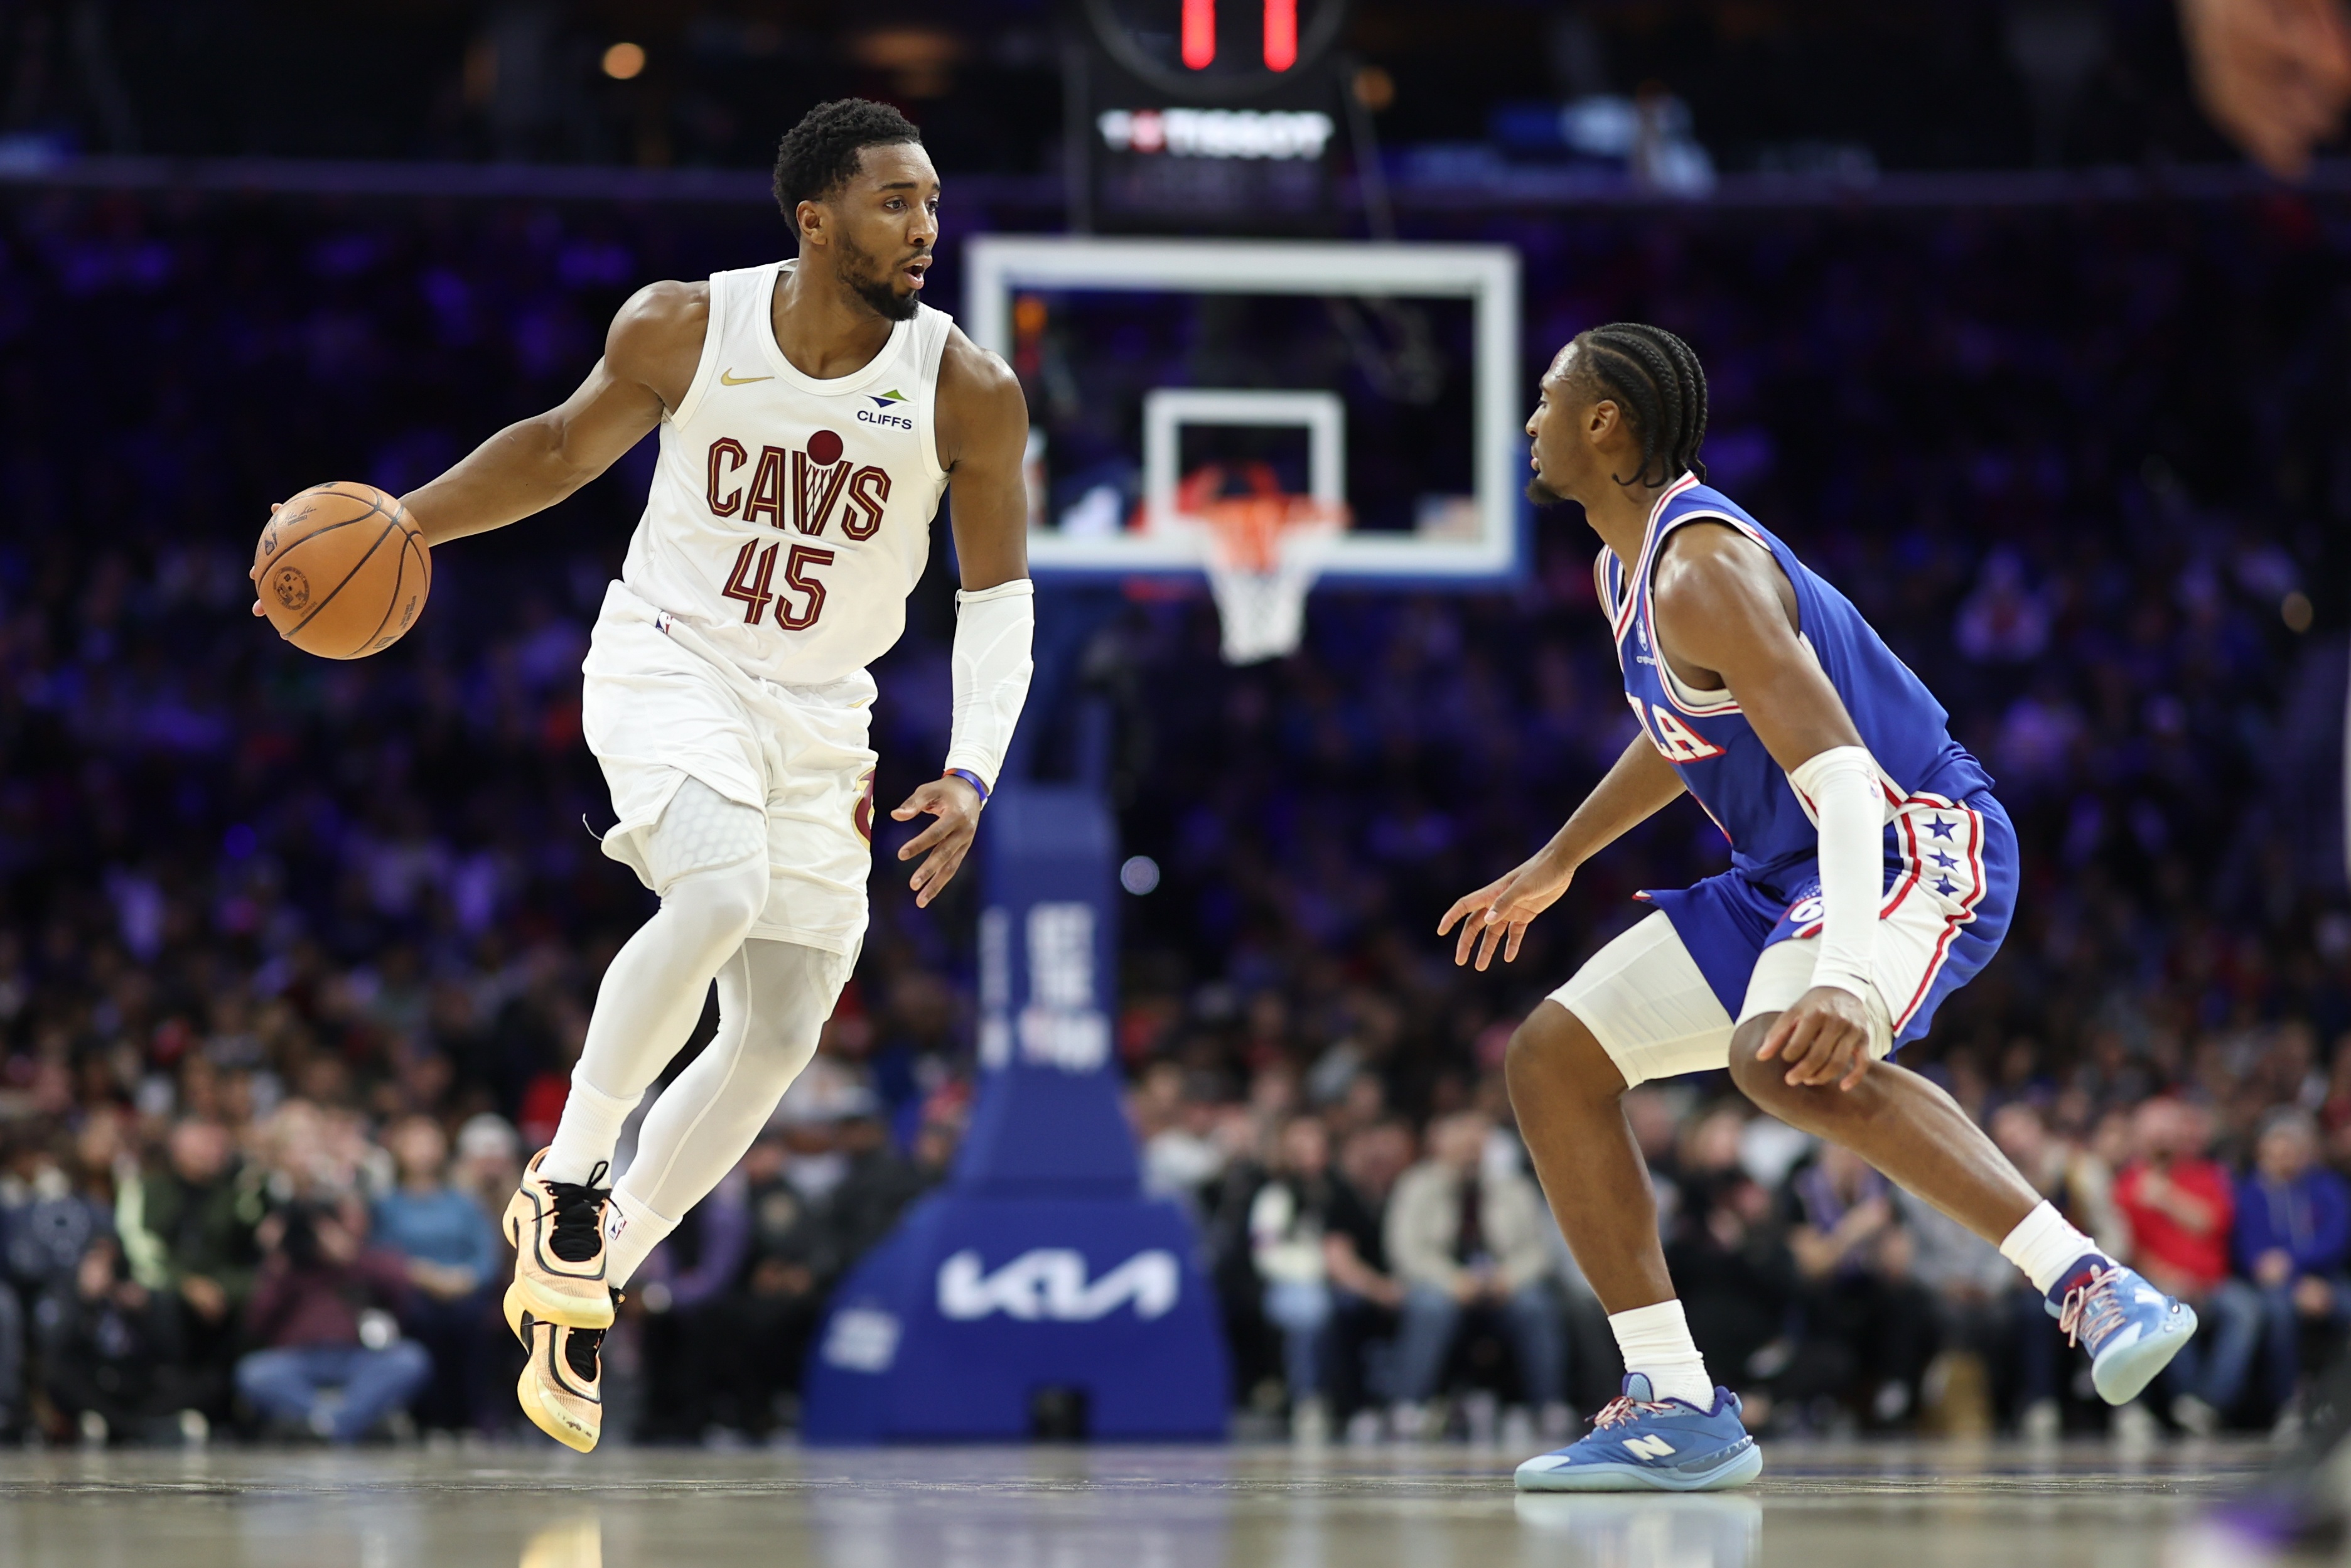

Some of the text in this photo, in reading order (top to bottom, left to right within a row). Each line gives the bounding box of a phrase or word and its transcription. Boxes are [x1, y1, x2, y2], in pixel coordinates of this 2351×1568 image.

[856, 410, 913, 430] CLIFFS
[706, 434, 891, 542] CAVS
[721, 537, 836, 631] 45
